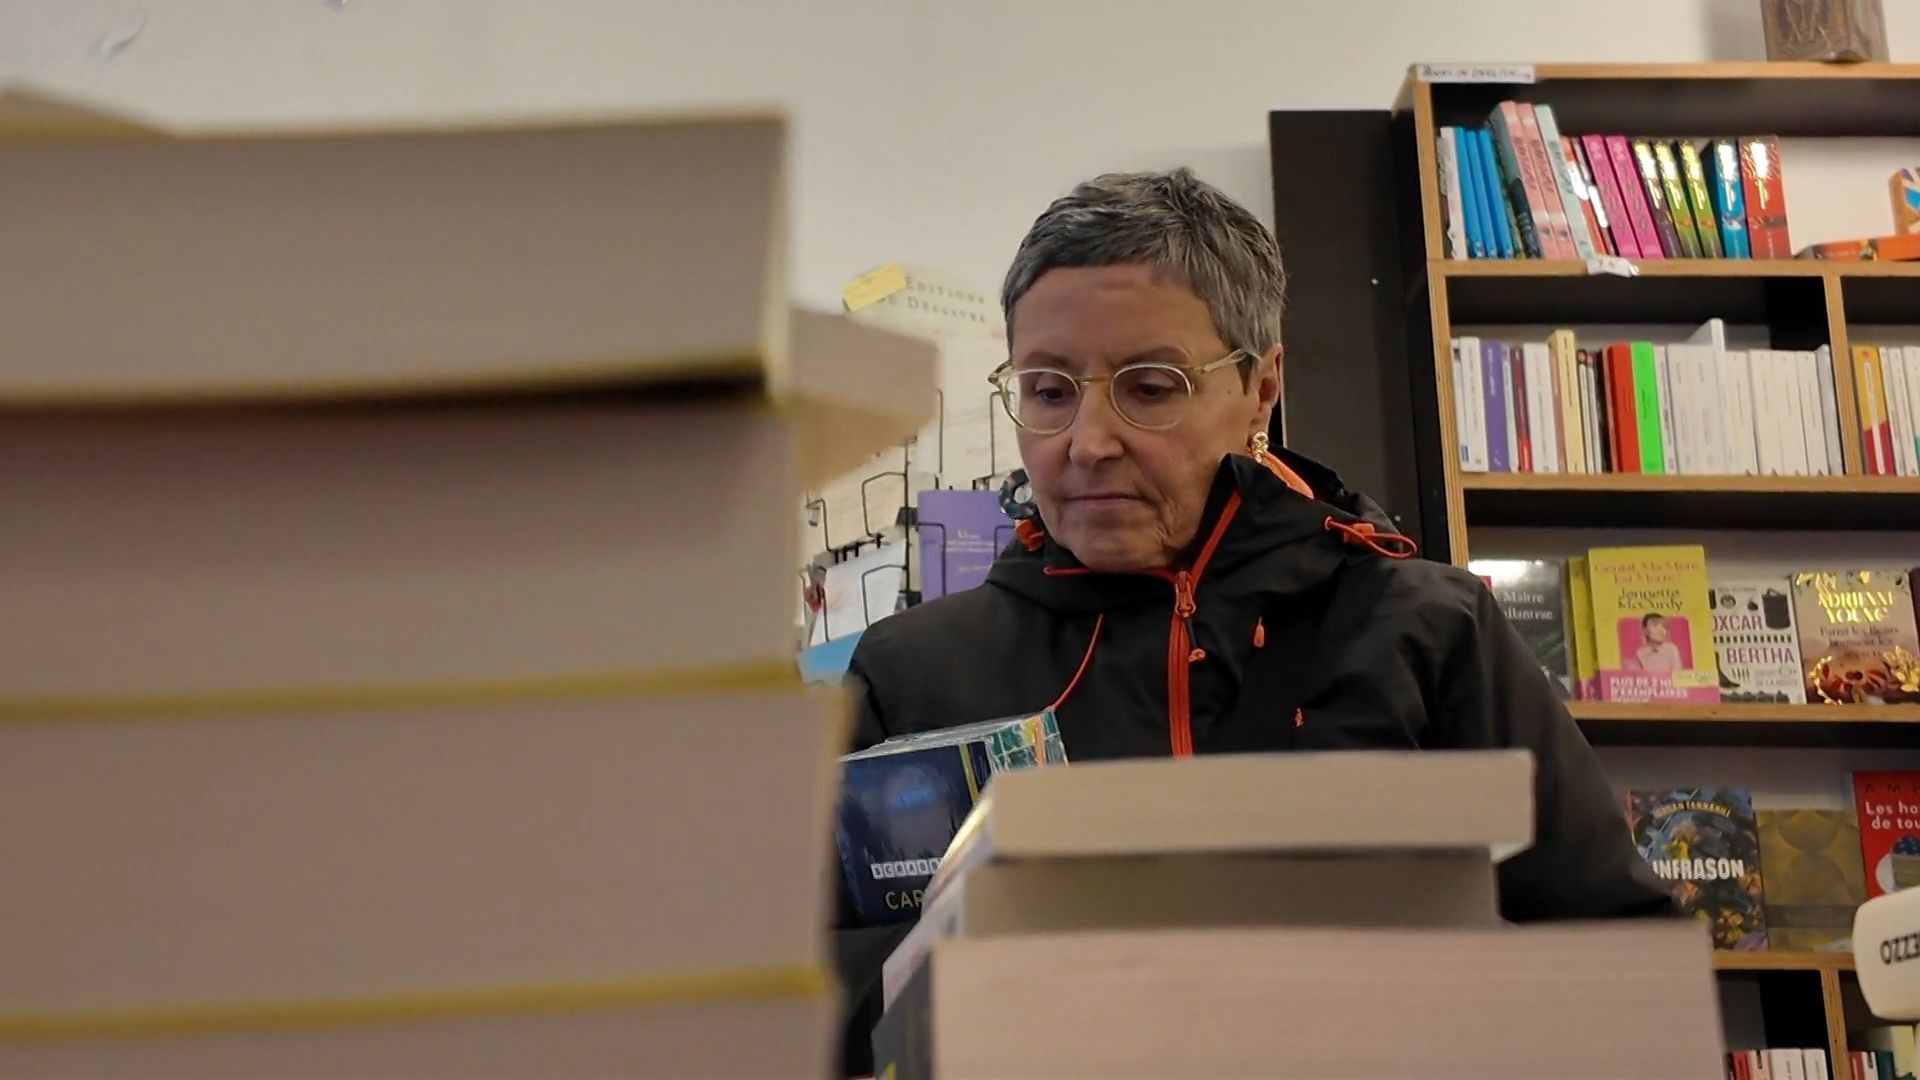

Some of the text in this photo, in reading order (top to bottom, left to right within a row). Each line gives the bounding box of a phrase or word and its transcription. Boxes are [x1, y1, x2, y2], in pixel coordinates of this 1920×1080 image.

[1726, 647, 1795, 664] BERTHA
[1865, 802, 1893, 816] Les
[1871, 815, 1891, 830] de
[1652, 857, 1744, 880] INFRASON
